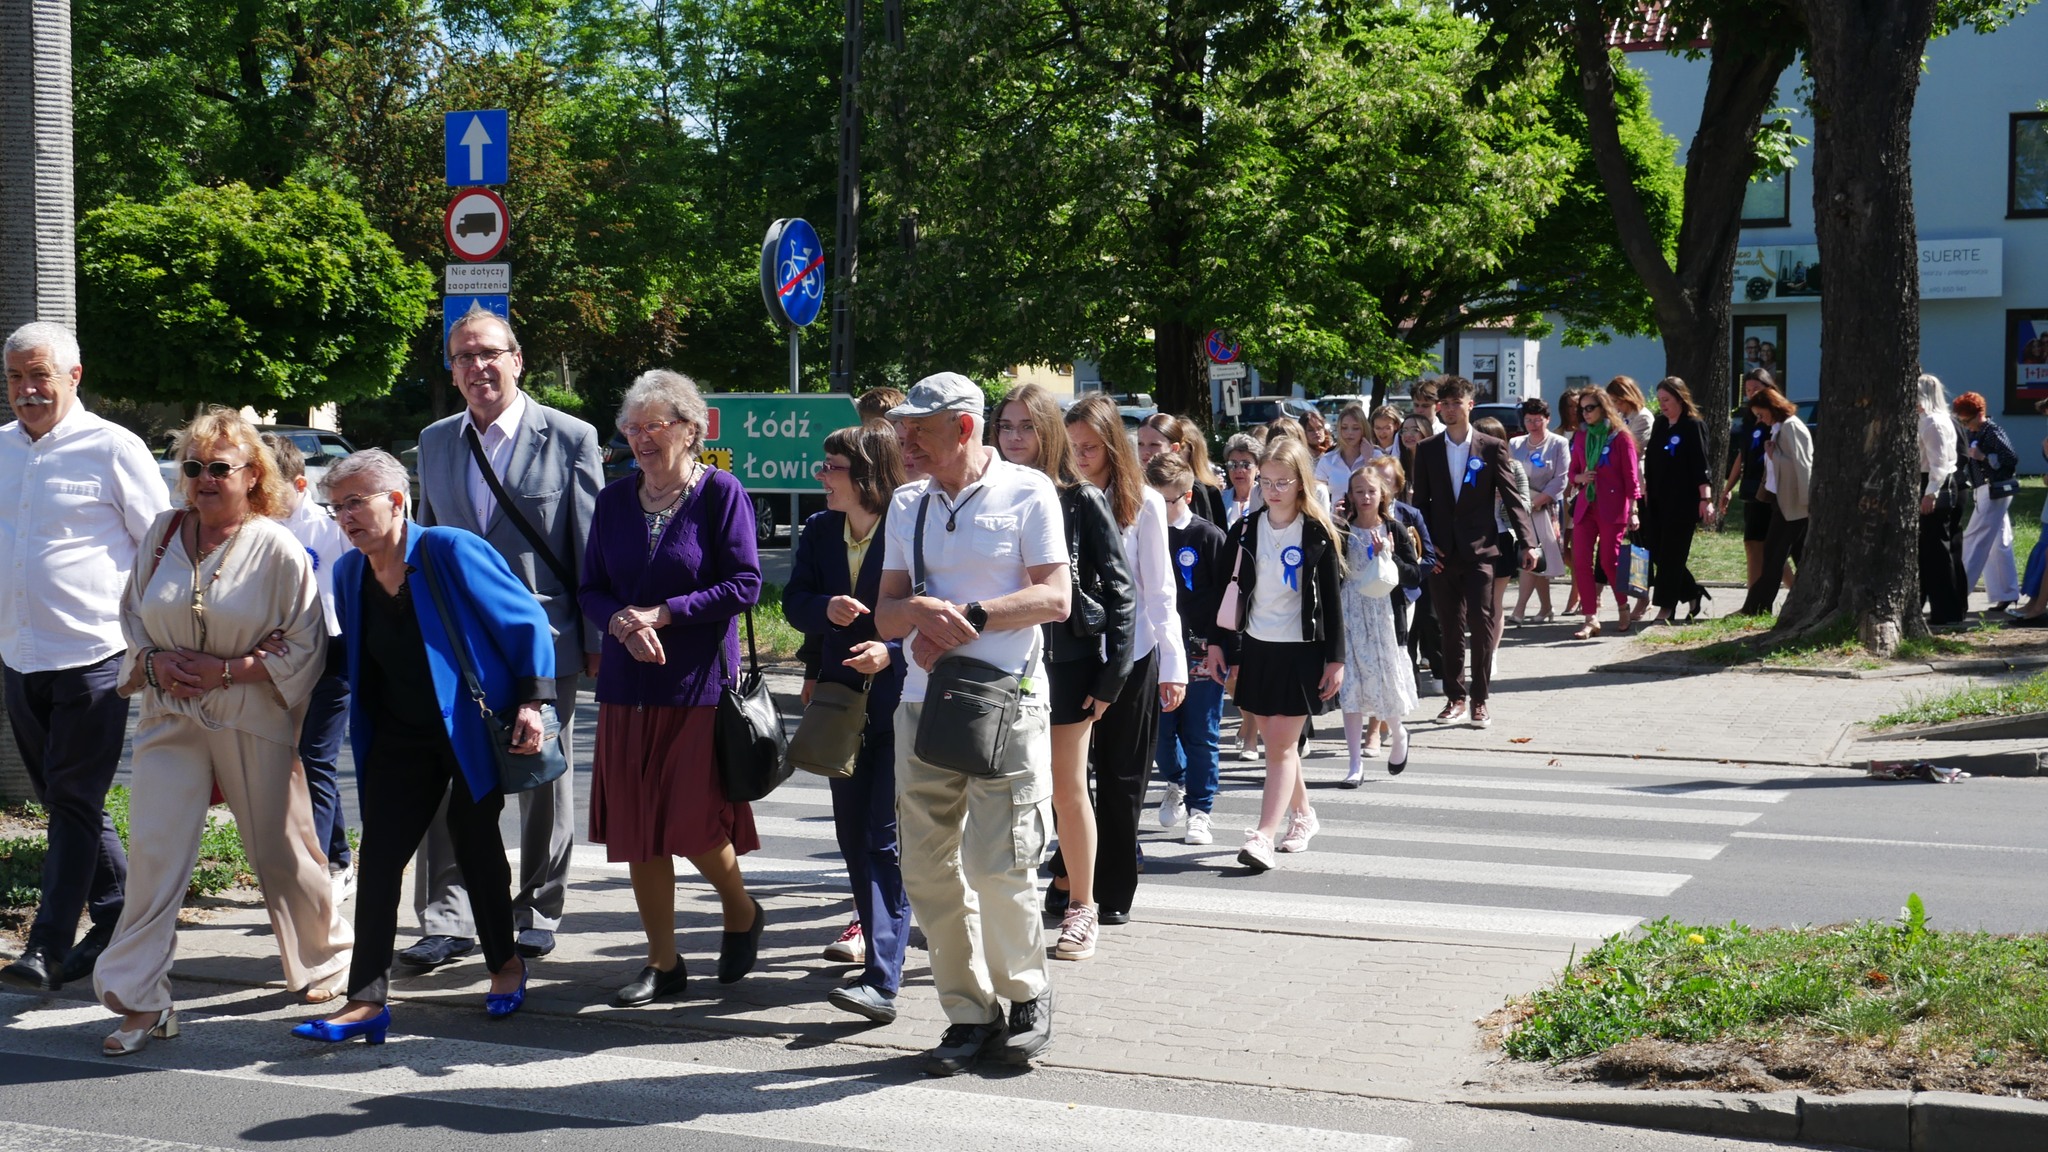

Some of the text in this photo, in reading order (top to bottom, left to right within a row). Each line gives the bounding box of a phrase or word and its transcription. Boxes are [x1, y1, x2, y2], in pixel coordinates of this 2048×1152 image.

[1922, 248, 1981, 263] SUERTE
[451, 266, 504, 277] Nie dotyczy
[448, 280, 508, 292] zaopatrzenia
[1508, 352, 1516, 395] KANTOR
[743, 411, 810, 438] Łódź
[743, 452, 823, 479] Łowic
